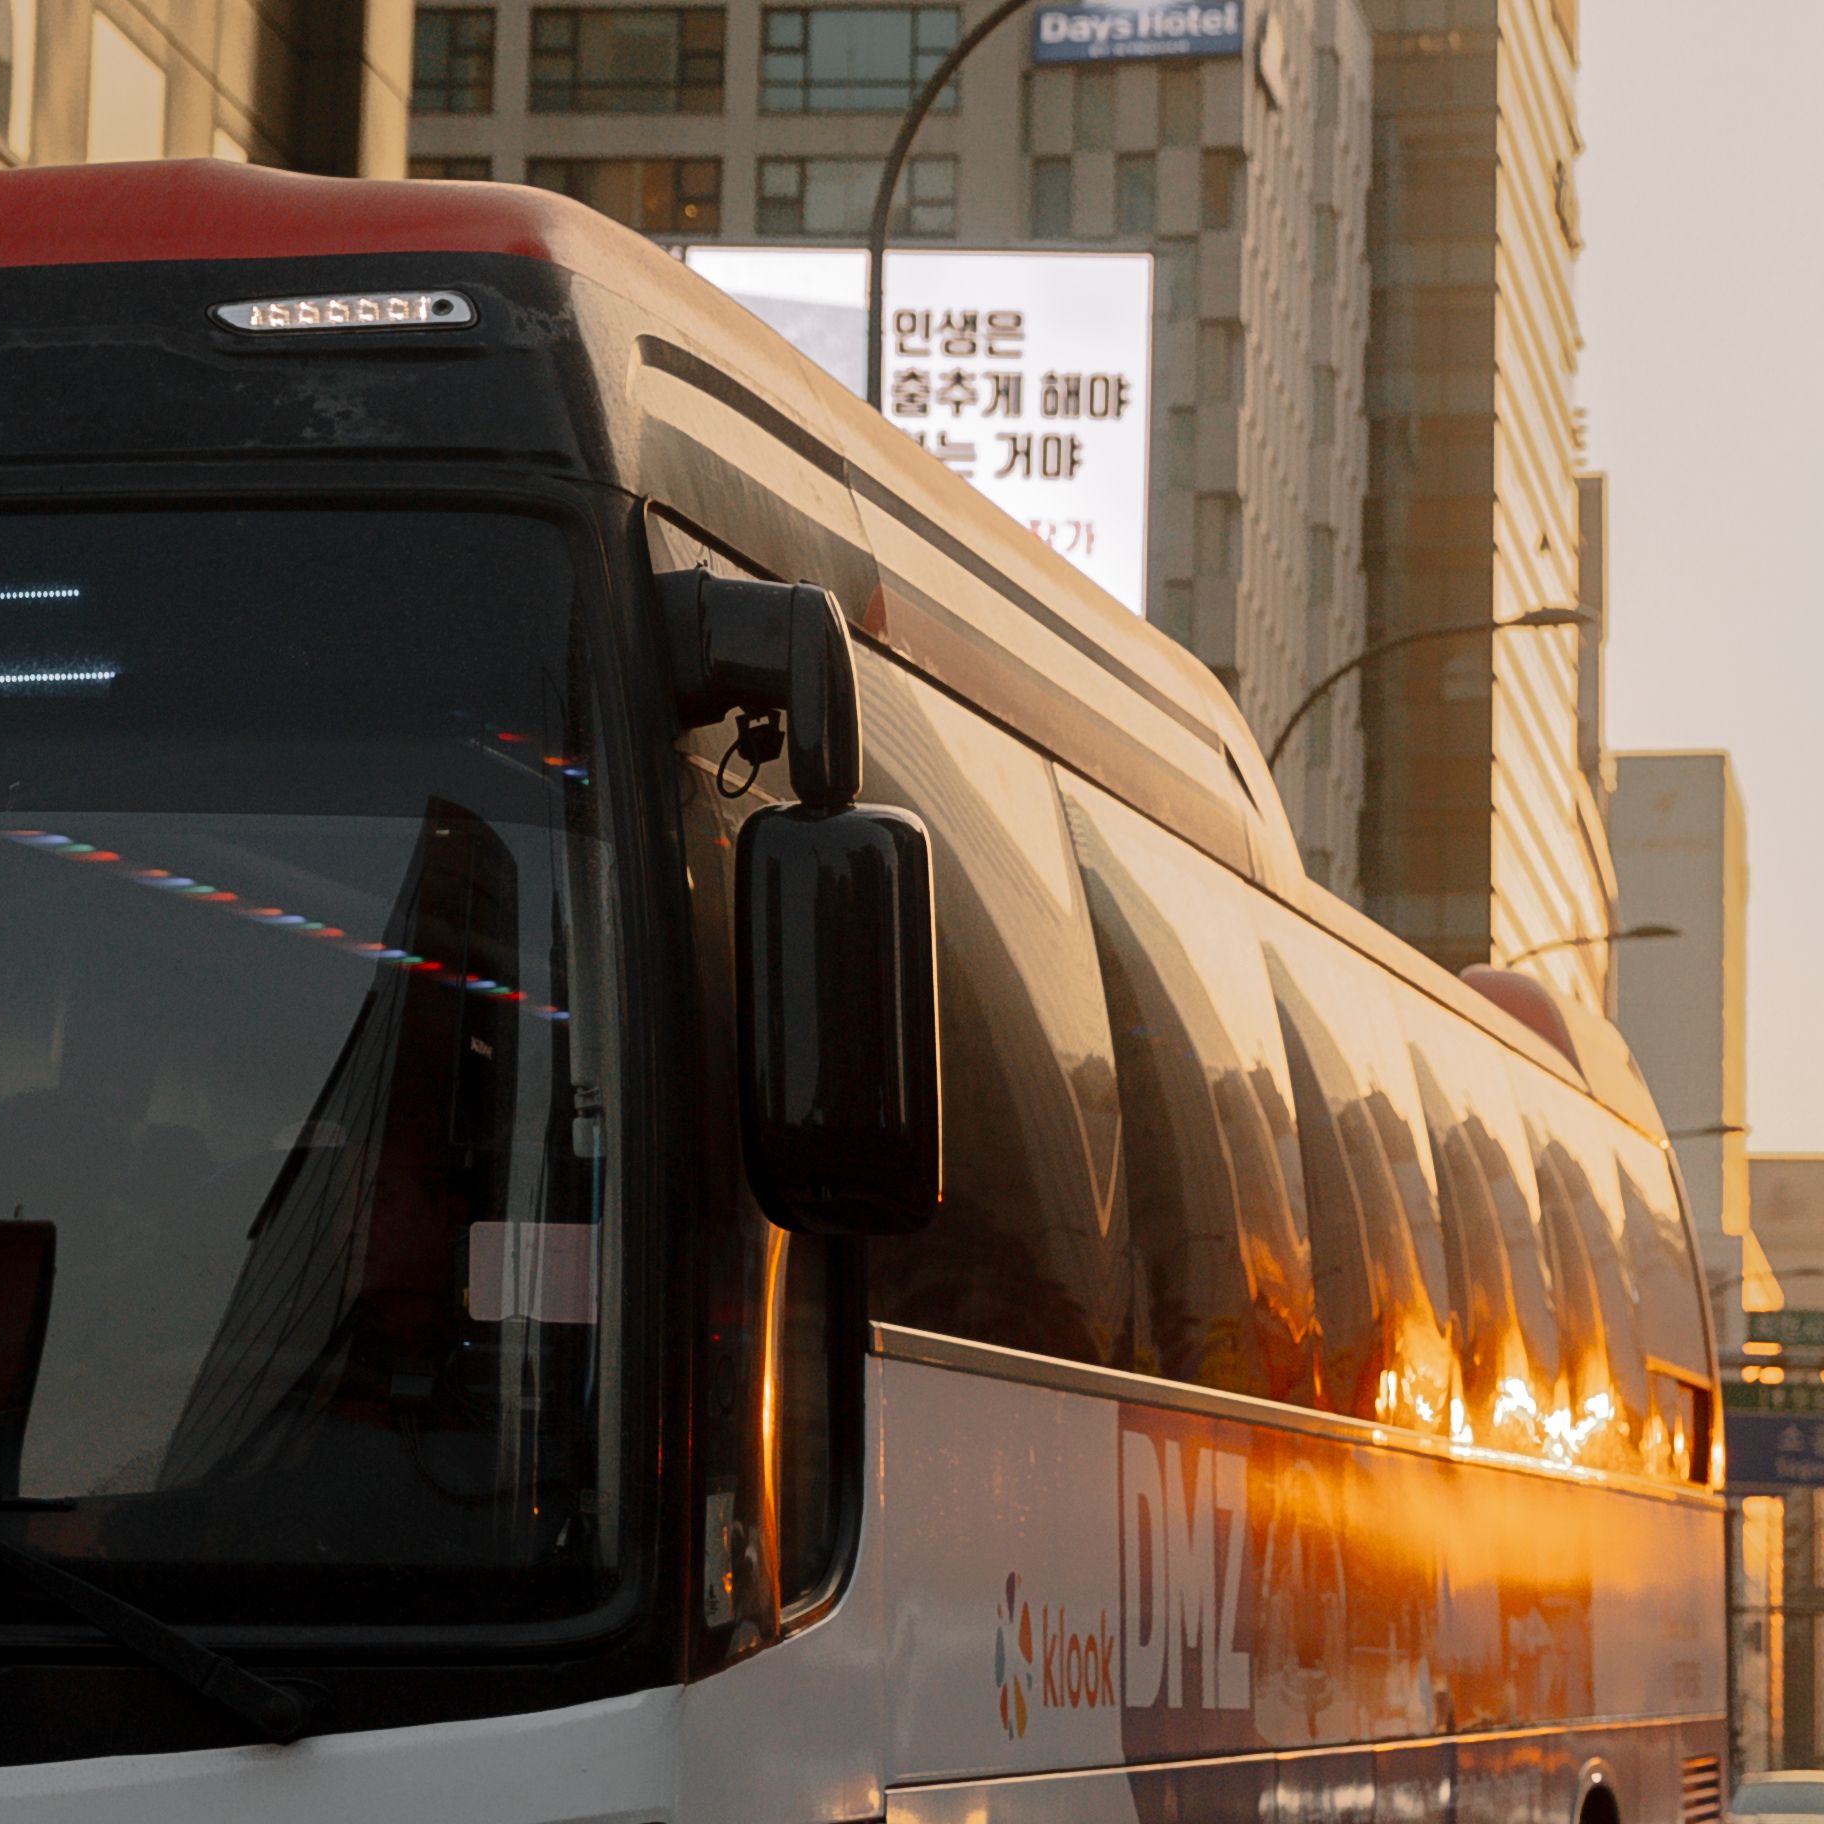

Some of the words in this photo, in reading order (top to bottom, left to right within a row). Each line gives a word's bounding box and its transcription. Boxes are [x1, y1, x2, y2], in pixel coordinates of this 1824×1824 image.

[1040, 12, 1132, 45] Days
[1137, 1, 1239, 38] Hotel
[894, 310, 1024, 358] 인생은
[892, 367, 1023, 417] 춤추게
[1041, 370, 1131, 419] 해야
[905, 430, 976, 477] 는
[995, 432, 1081, 480] 거야
[1122, 1430, 1250, 1710] DMZ
[1042, 1604, 1115, 1707] klook
